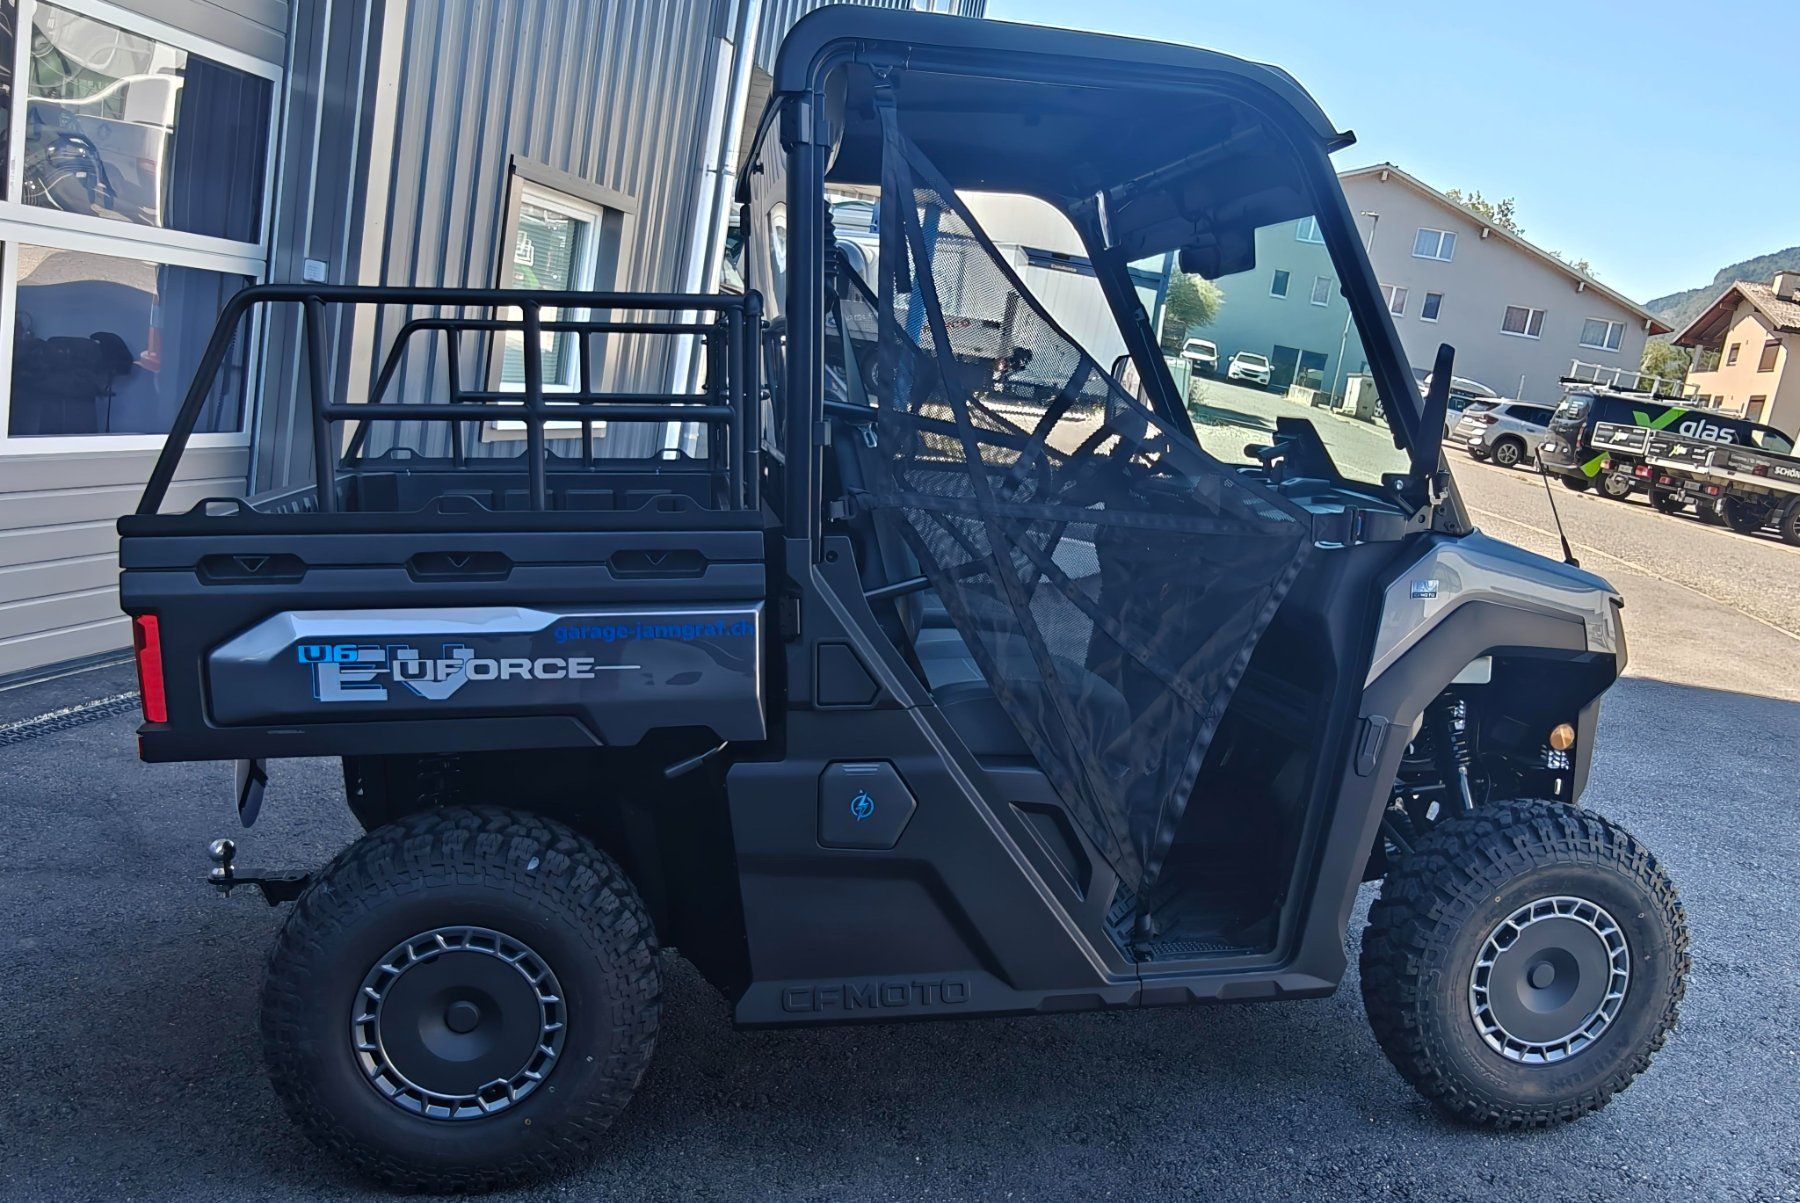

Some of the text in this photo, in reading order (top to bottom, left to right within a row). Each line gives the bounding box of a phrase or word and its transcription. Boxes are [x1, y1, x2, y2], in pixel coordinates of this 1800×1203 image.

[1679, 419, 1735, 445] glas
[554, 619, 754, 644] garage-janngraf.ch
[297, 644, 358, 663] U6
[393, 657, 595, 682] UFORCE
[782, 978, 971, 1013] CFMOTO
